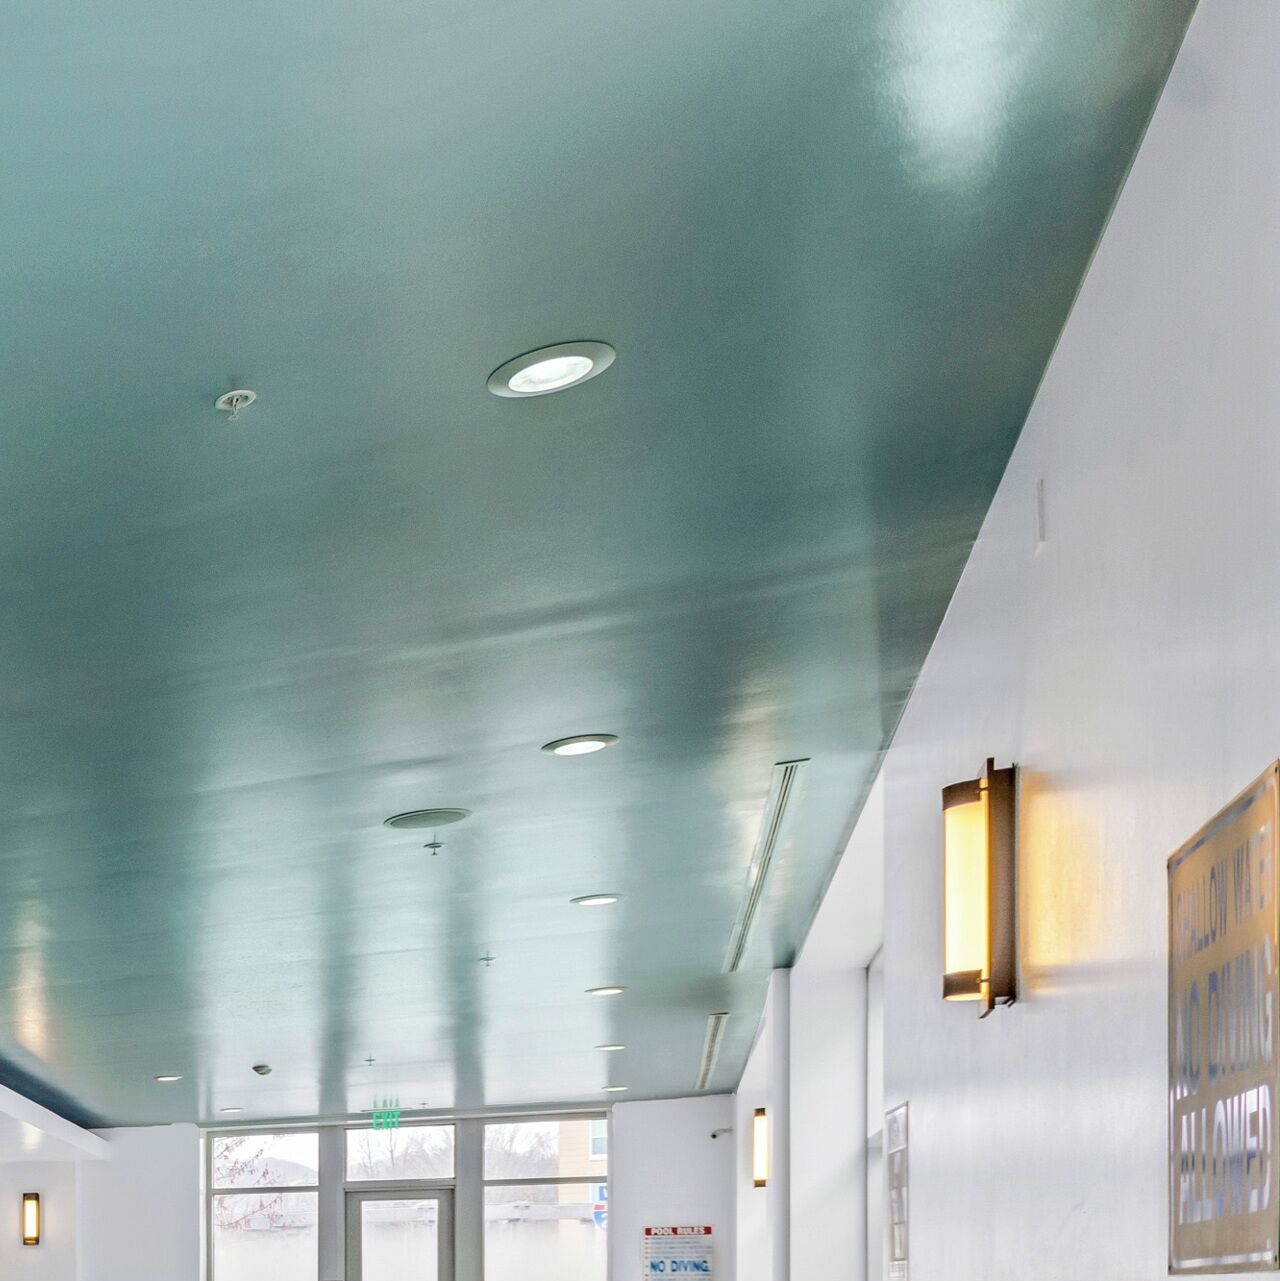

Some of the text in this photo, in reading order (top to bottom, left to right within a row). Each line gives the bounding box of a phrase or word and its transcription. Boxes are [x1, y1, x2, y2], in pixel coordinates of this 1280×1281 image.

[1176, 856, 1228, 966] SHALLOW
[1176, 932, 1273, 1100] NO DIVING
[372, 1112, 400, 1130] EXIT
[1179, 1084, 1272, 1225] ALLOWED
[652, 1226, 705, 1235] POOL RULES
[650, 1260, 665, 1272] NO
